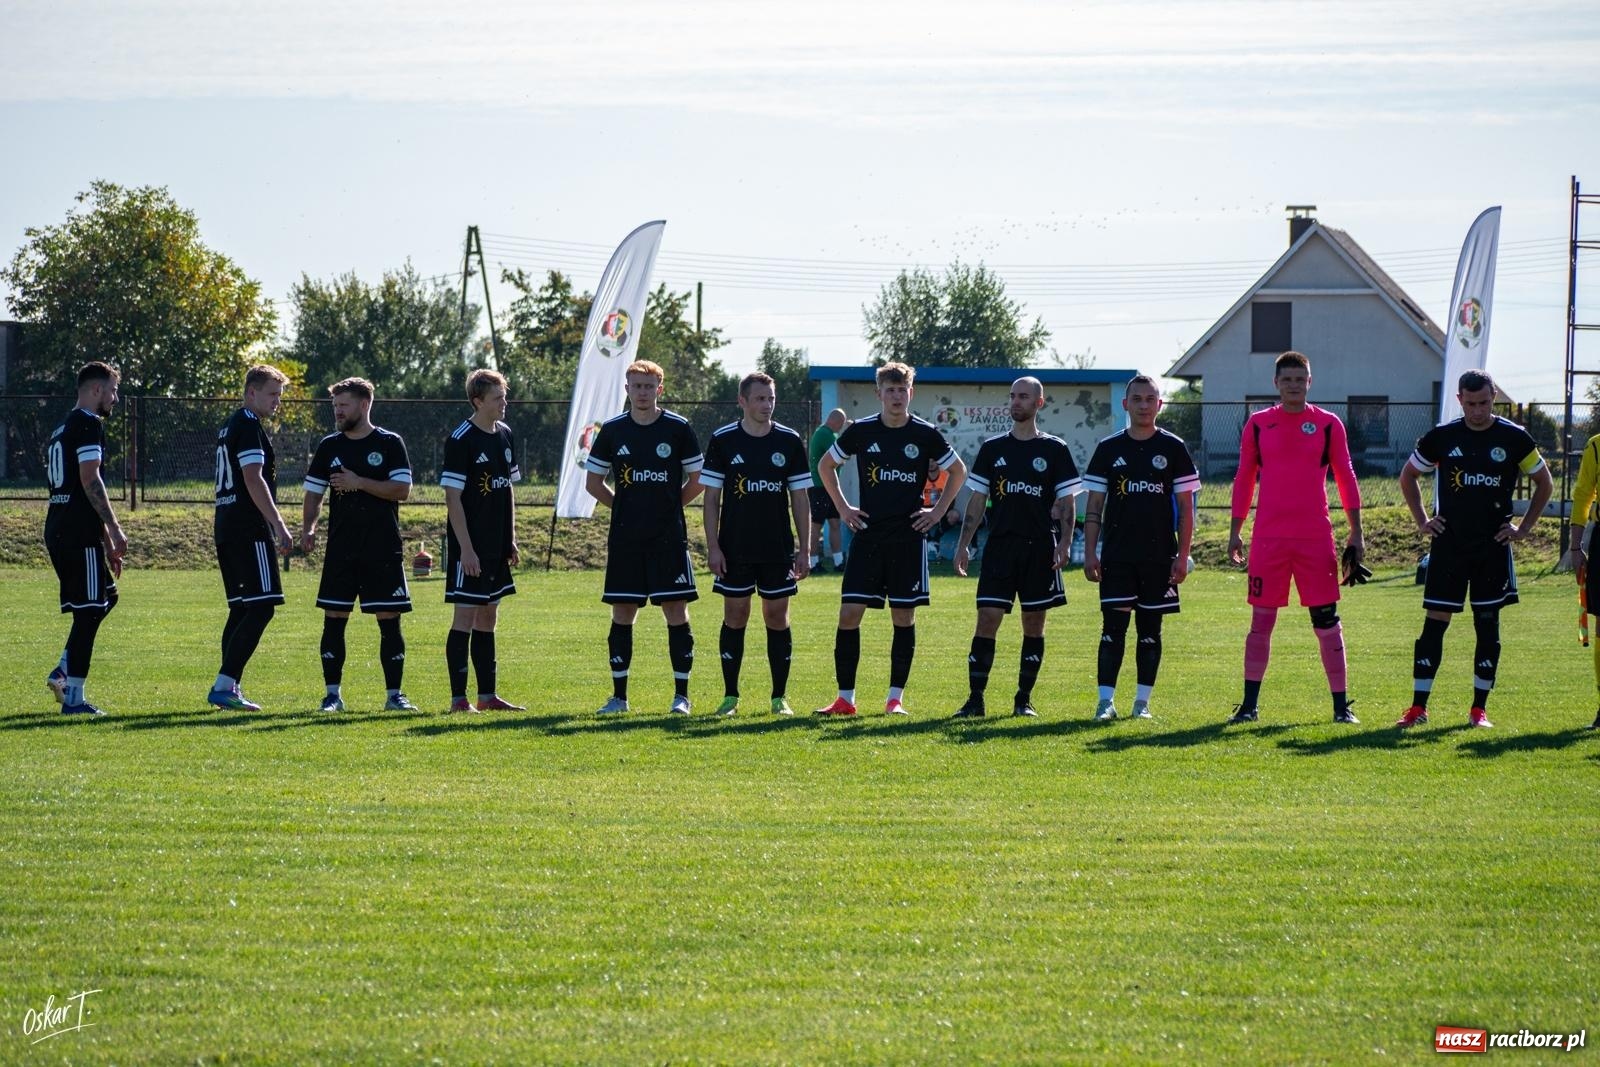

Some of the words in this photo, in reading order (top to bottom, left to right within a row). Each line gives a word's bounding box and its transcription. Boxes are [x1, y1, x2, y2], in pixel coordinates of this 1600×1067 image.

[963, 407, 983, 416] LKS
[986, 407, 1012, 416] ZGO
[969, 415, 1013, 424] ZAWADA
[491, 476, 512, 489] InPos
[632, 469, 669, 483] InPost
[880, 468, 918, 483] InPost
[1464, 473, 1501, 487] InPost
[747, 479, 783, 493] InPost
[1006, 481, 1043, 497] InPost
[1128, 480, 1164, 494] InPost
